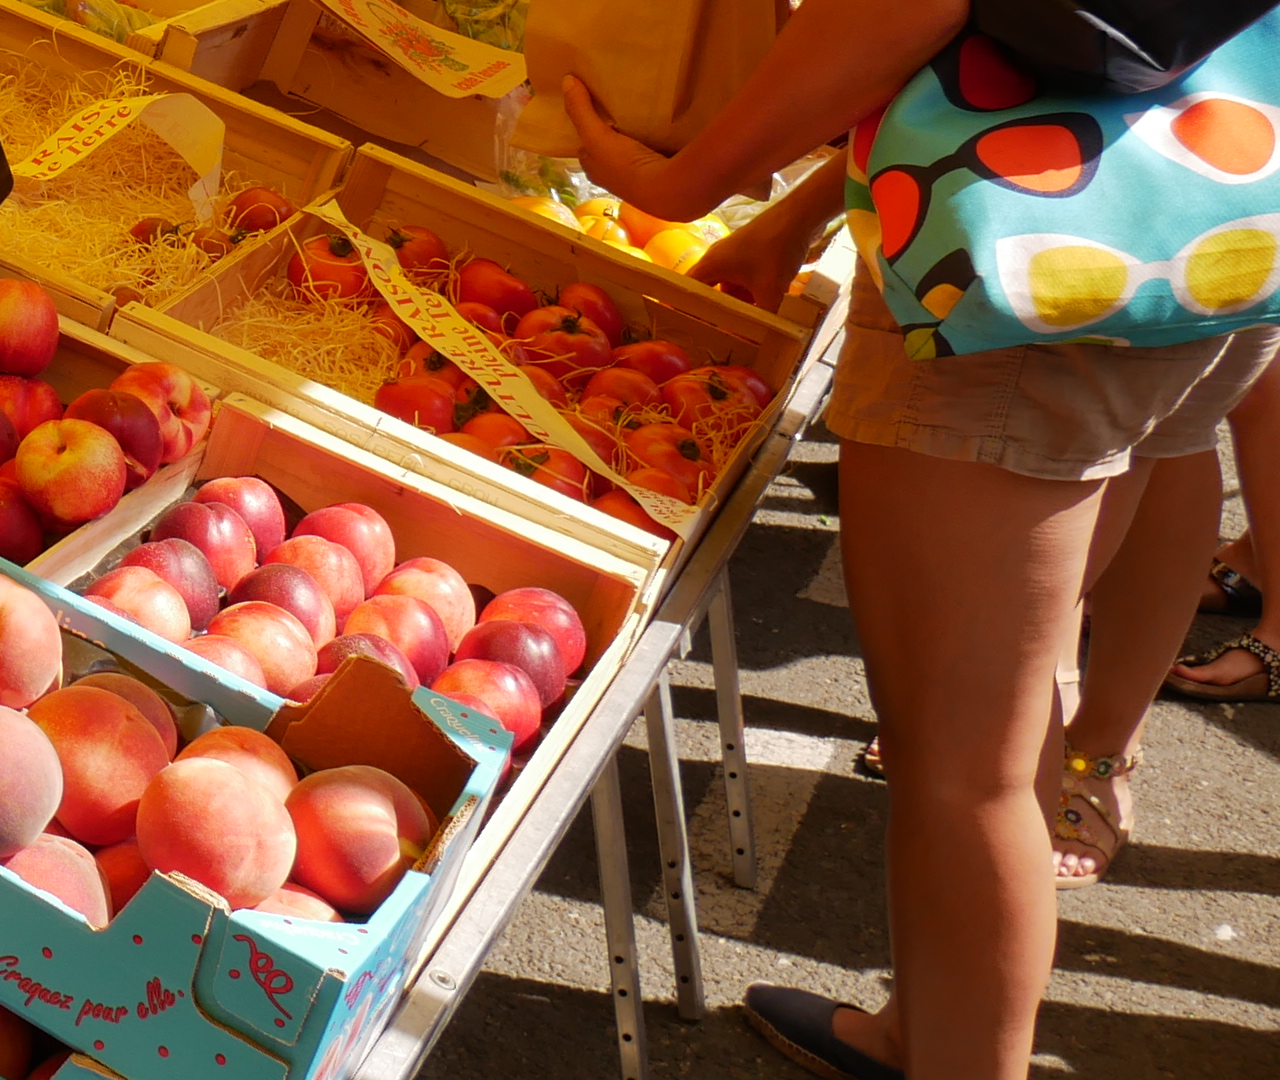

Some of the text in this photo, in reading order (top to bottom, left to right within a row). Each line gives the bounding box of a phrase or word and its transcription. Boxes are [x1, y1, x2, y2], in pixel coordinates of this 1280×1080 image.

[61, 105, 132, 157] Terre
[451, 324, 519, 380] Pleine
[74, 997, 129, 1027] pour
